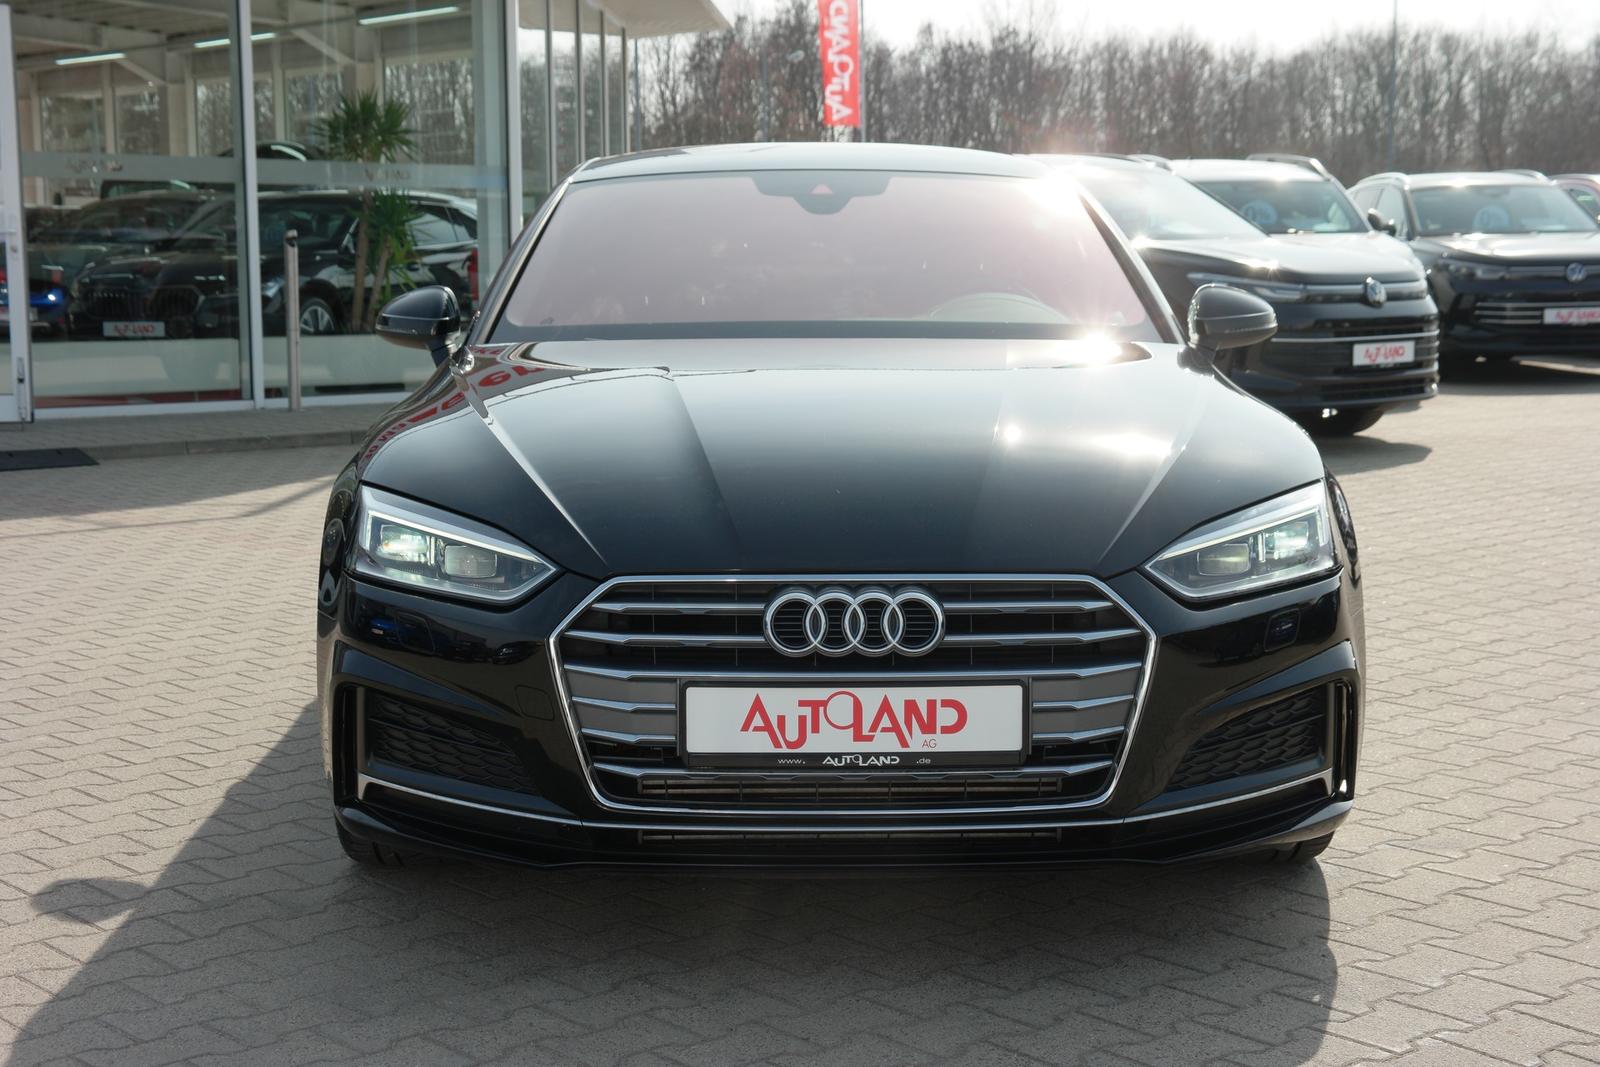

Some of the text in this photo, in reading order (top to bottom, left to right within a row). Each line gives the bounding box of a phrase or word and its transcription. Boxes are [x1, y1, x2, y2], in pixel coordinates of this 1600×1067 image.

[740, 690, 968, 750] AUTOLAND
[922, 738, 937, 748] AG
[777, 757, 806, 765] www.
[916, 756, 932, 765] .de
